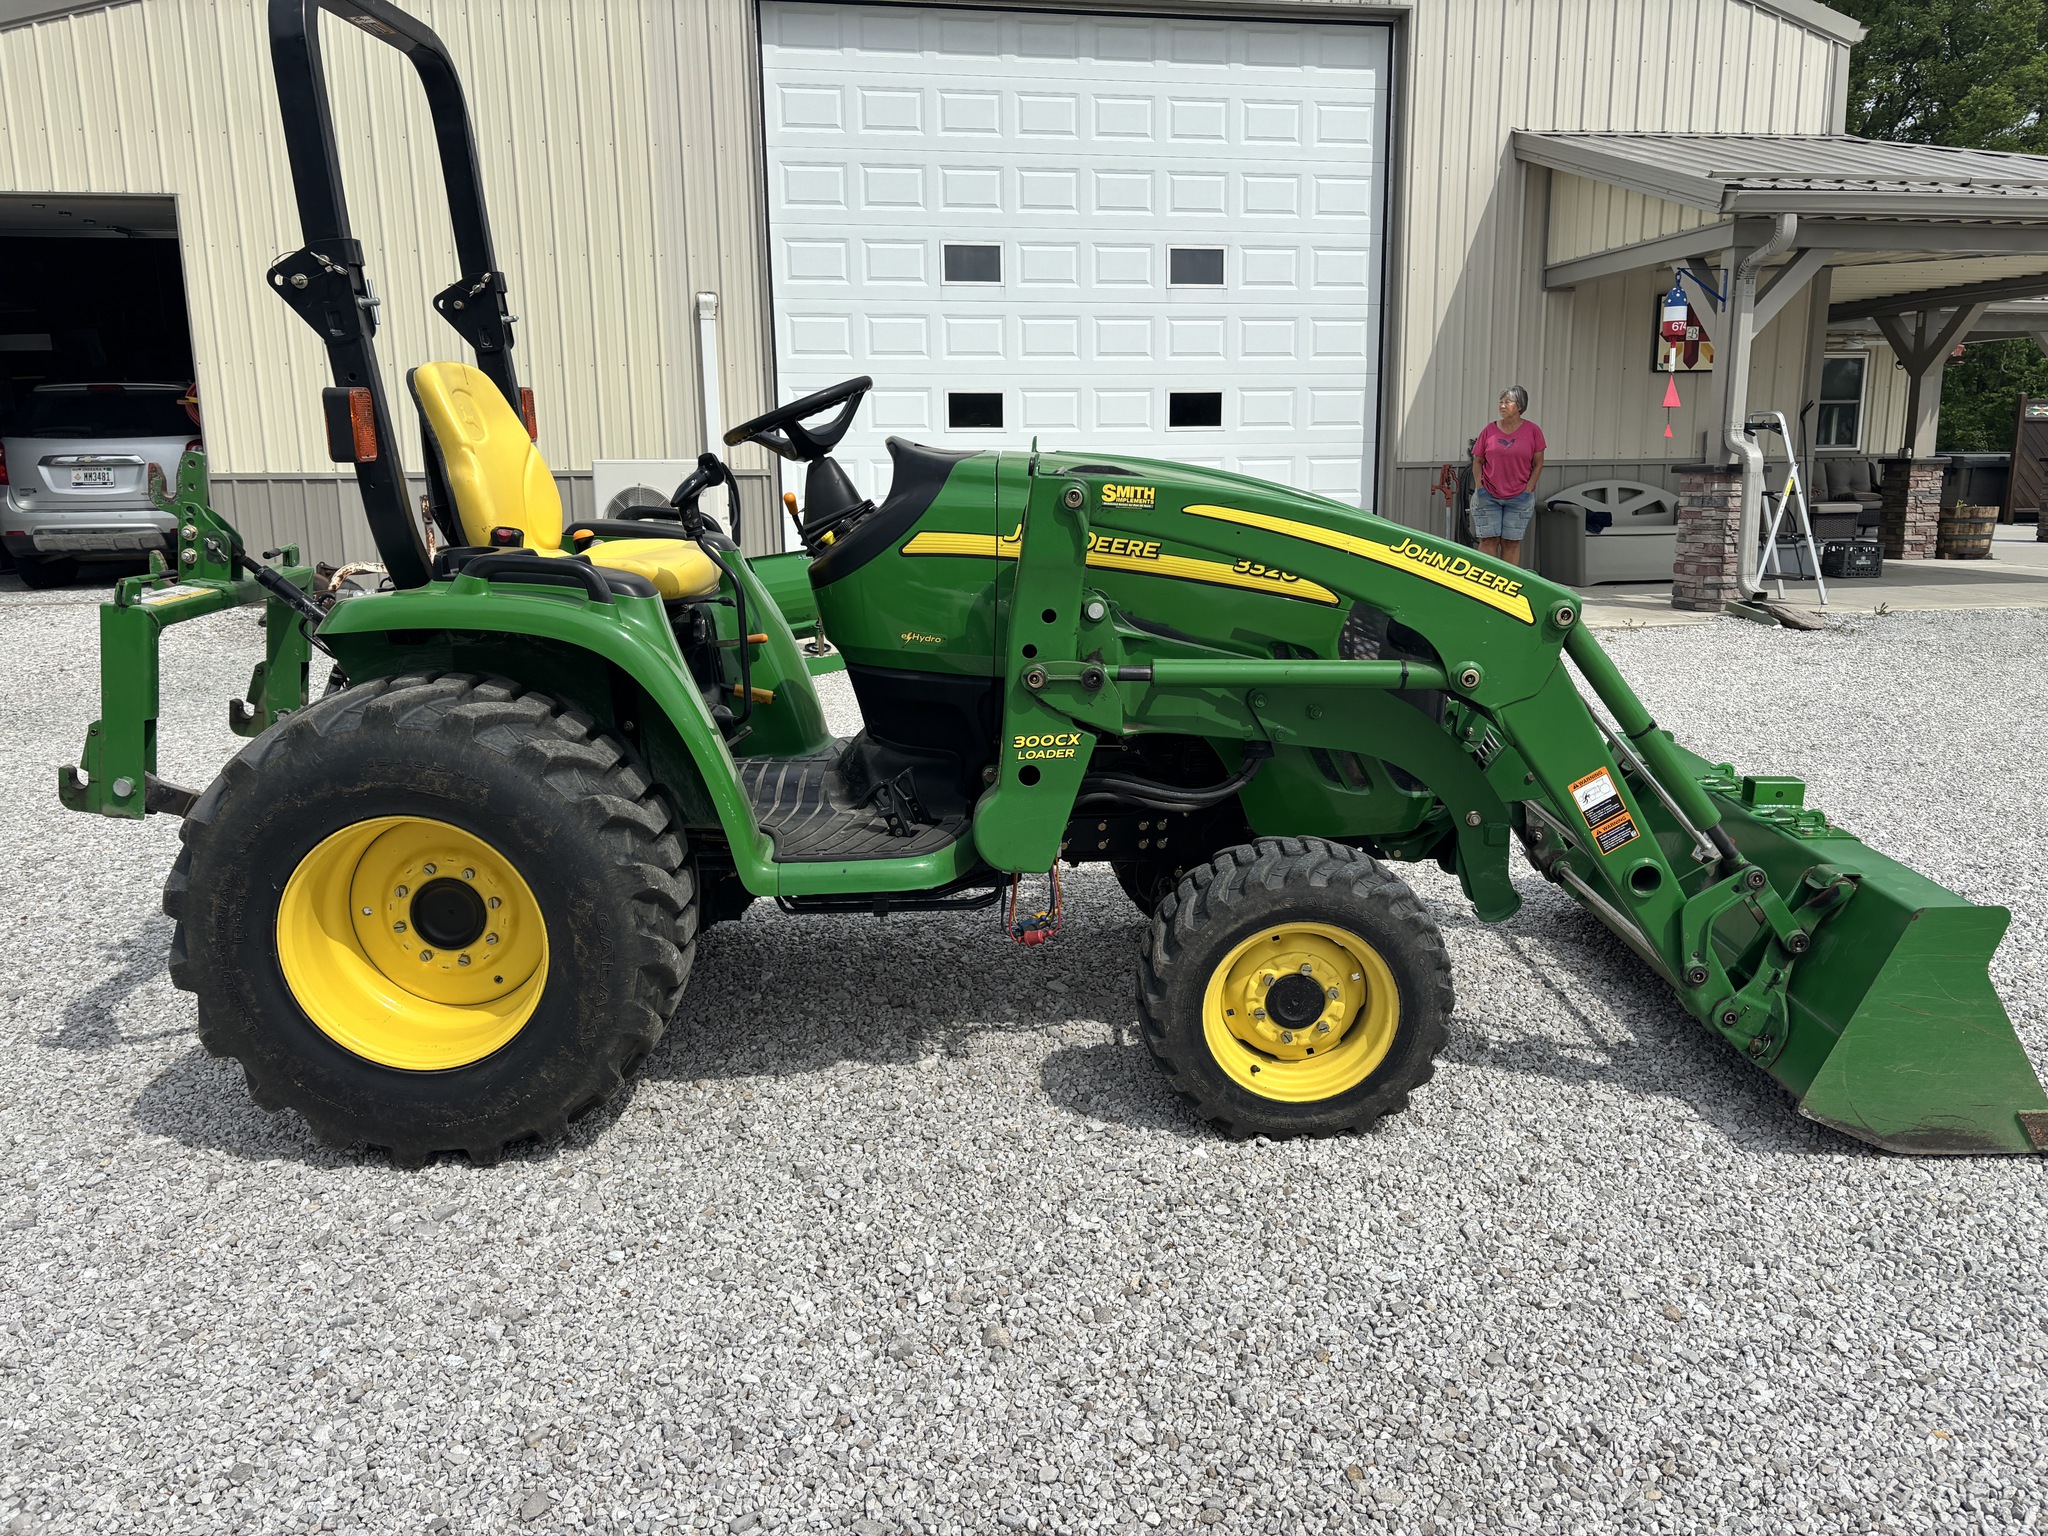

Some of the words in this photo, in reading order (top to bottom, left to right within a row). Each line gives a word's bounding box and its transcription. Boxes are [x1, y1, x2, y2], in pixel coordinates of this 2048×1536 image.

[1101, 483, 1156, 502] SMITH
[1116, 497, 1155, 505] IMPLEMENTS
[1389, 537, 1451, 571] JOHN
[1448, 557, 1523, 597] DEERE
[1012, 733, 1082, 749] 300CX
[1017, 748, 1075, 760] LOADER
[1578, 770, 1603, 786] WARNING
[1602, 816, 1627, 831] WARNING
[1280, 896, 1397, 936] GALAXY
